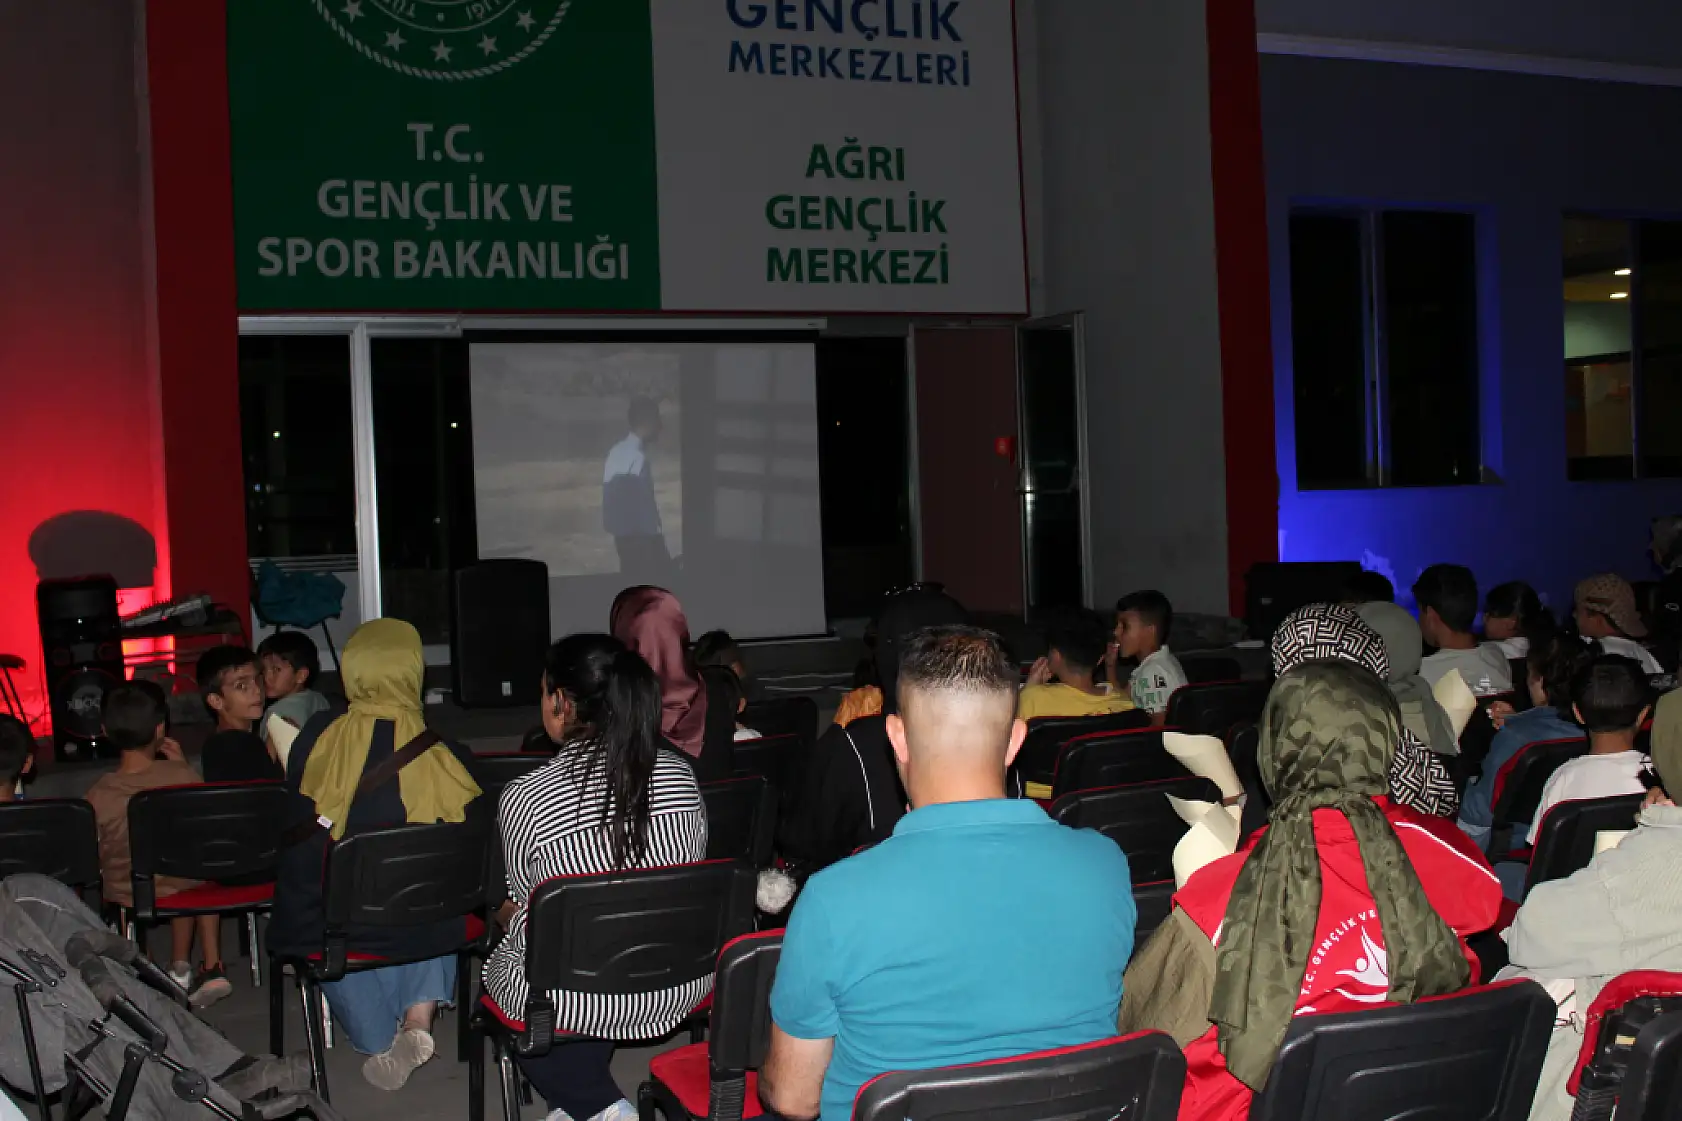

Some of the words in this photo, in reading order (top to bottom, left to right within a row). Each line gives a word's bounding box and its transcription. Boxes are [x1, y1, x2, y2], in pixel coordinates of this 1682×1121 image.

[728, 40, 970, 86] MERKEZLERİ
[406, 122, 485, 163] T.C.
[805, 136, 905, 181] AĞRI
[317, 173, 511, 231] GENÇLİK
[518, 183, 574, 222] VE
[765, 190, 947, 242] GENÇLİK
[257, 236, 381, 278] SPOR
[393, 234, 630, 281] BAKANLIĞI
[766, 242, 949, 284] MERKEZİ
[1357, 909, 1377, 921] VE
